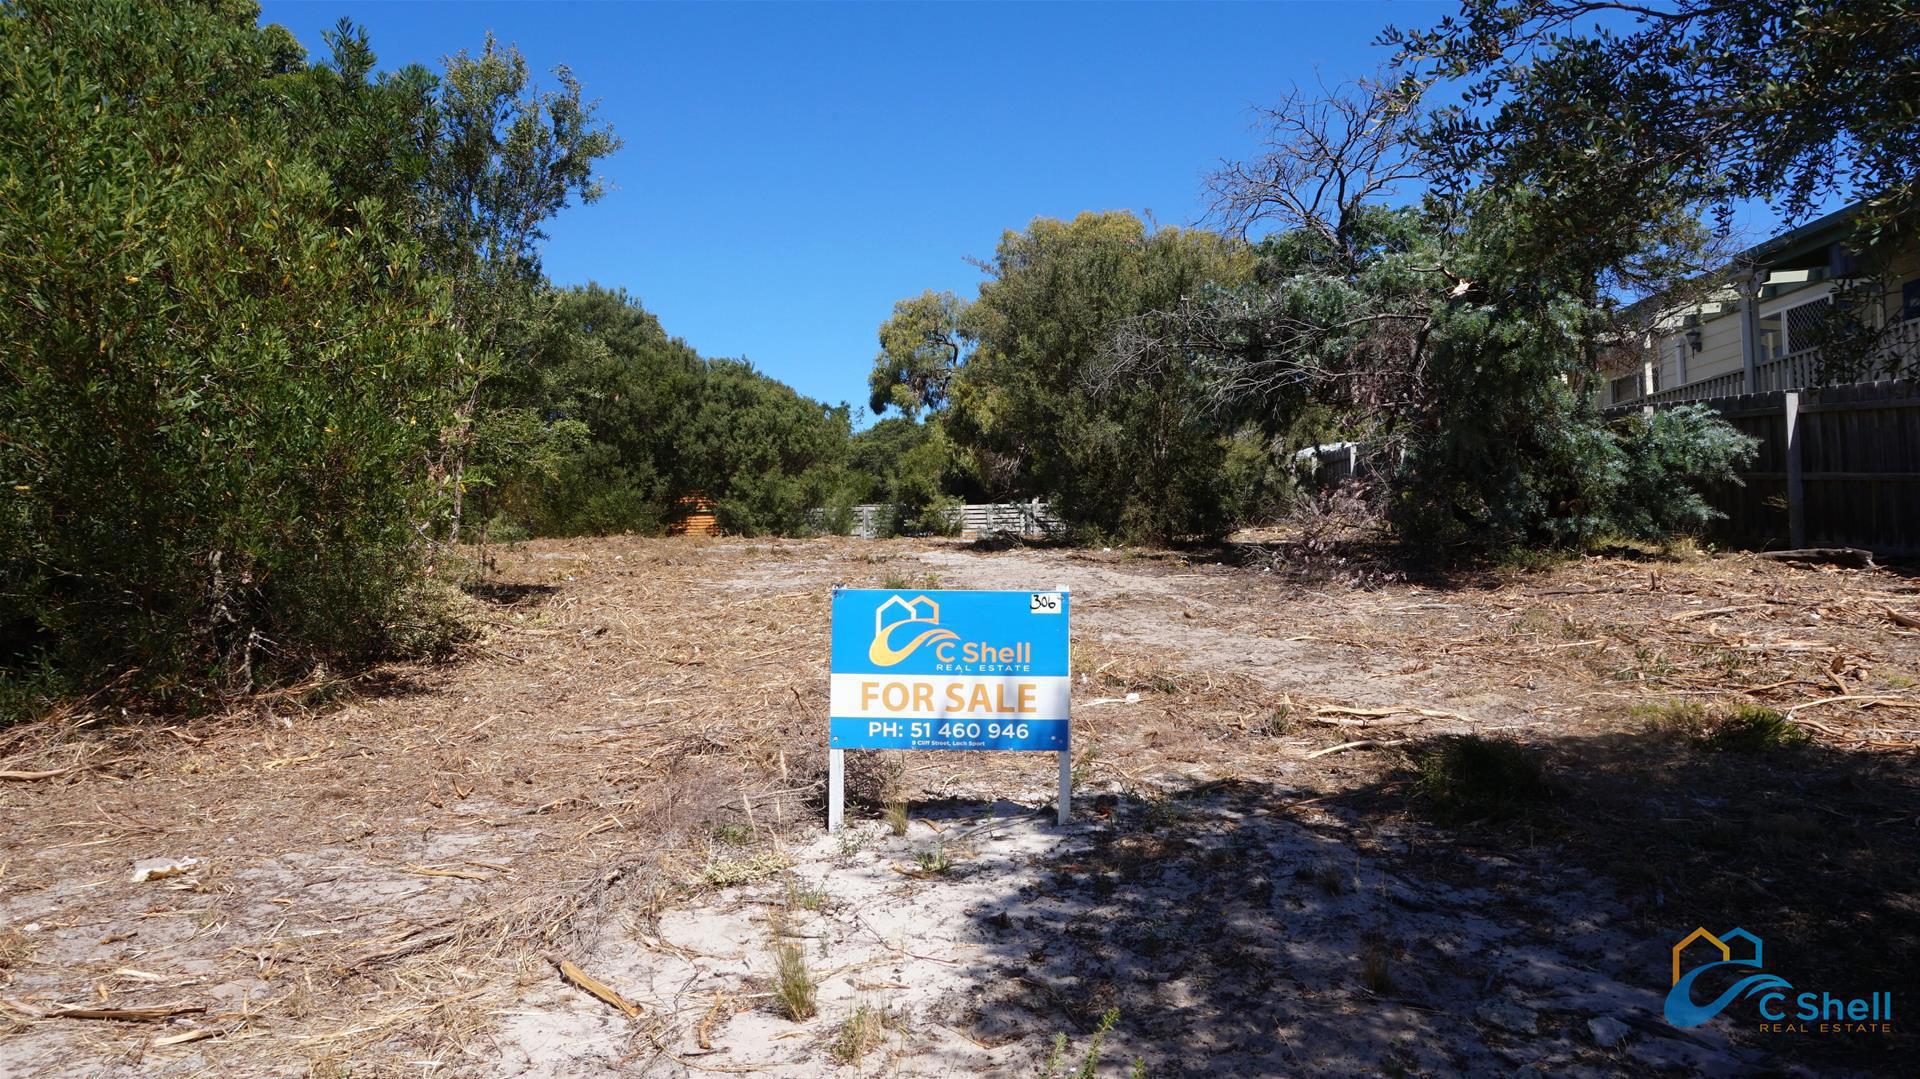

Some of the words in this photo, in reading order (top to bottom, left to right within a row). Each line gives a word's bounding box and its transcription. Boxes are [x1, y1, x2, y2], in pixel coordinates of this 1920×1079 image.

[1030, 594, 1056, 609] 306
[936, 642, 955, 663] C
[963, 642, 1031, 663] Shell
[936, 664, 972, 672] REAL
[979, 664, 1030, 672] ESTATE
[861, 682, 934, 712] FOR
[945, 684, 1037, 713] SALE
[869, 722, 903, 737] PH:
[910, 722, 931, 738] 51
[938, 723, 981, 739] 460
[988, 723, 1029, 739] 946
